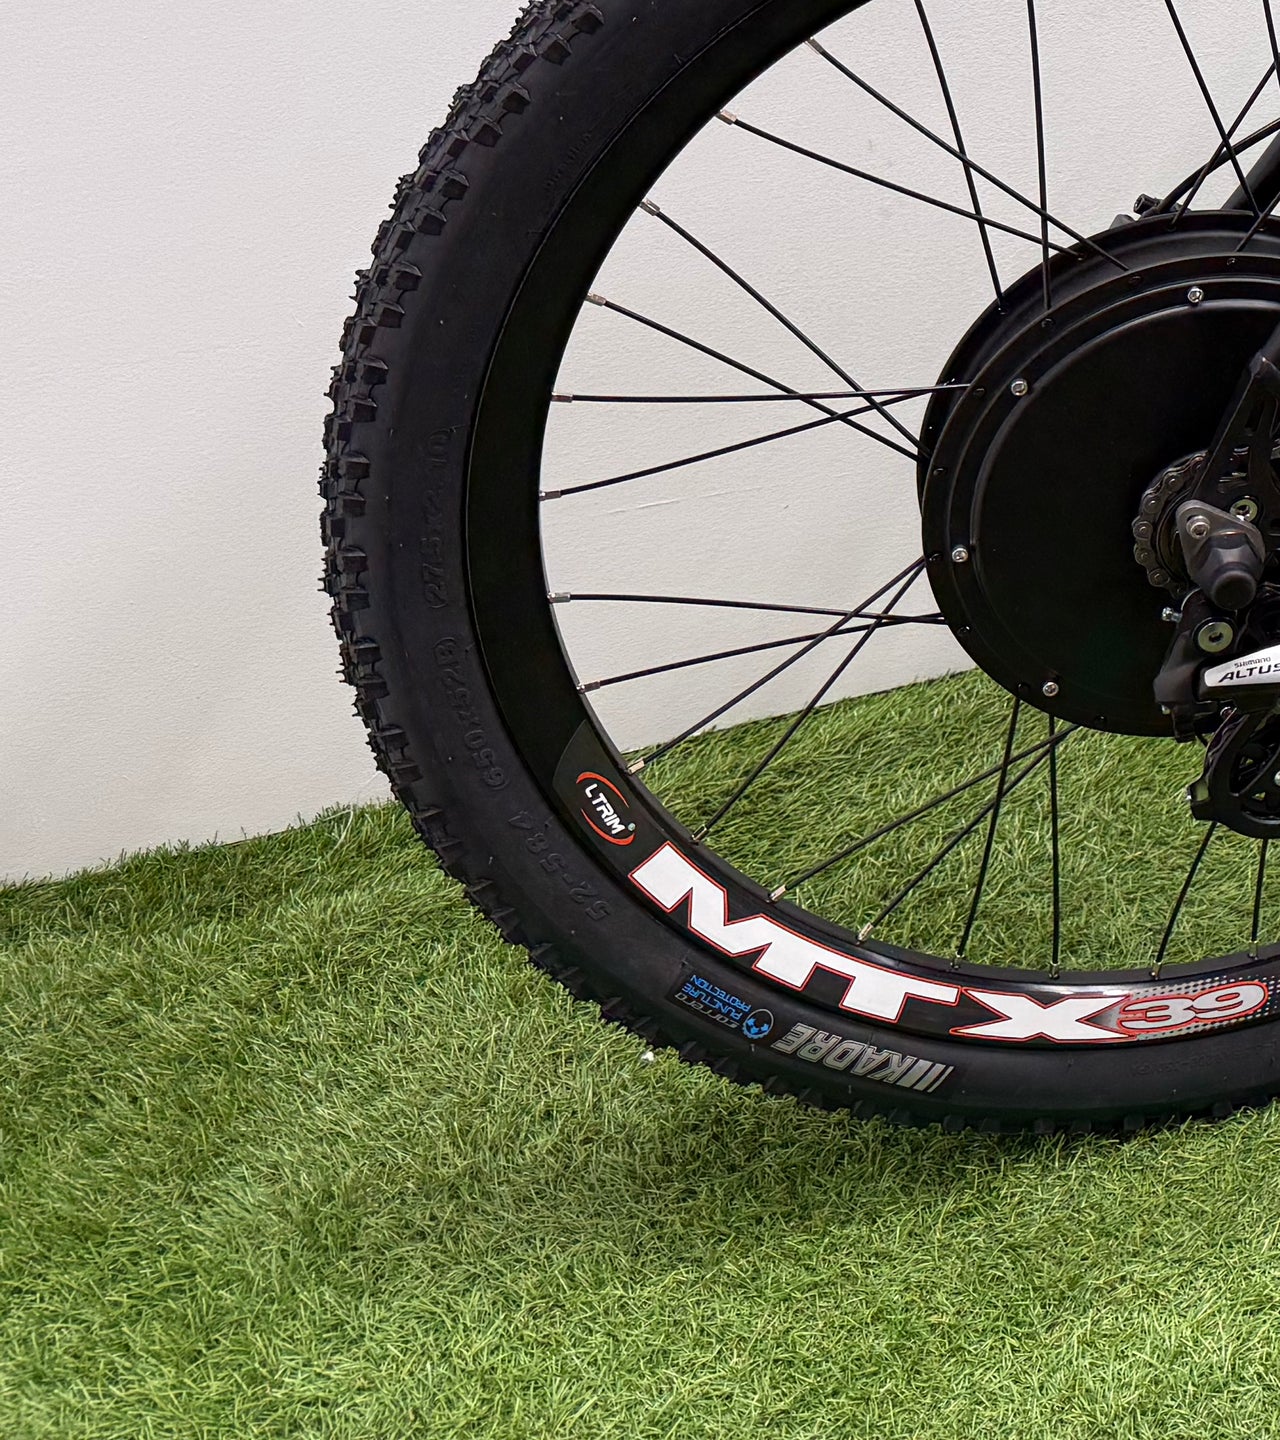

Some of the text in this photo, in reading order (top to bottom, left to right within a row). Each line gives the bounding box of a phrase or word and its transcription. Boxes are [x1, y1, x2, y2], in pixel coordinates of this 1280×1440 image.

[1234, 657, 1271, 669] SHIMANO
[682, 983, 743, 1021] PUNCTURE
[691, 974, 752, 1012] PROTECTION
[770, 1022, 917, 1085] KADRE
